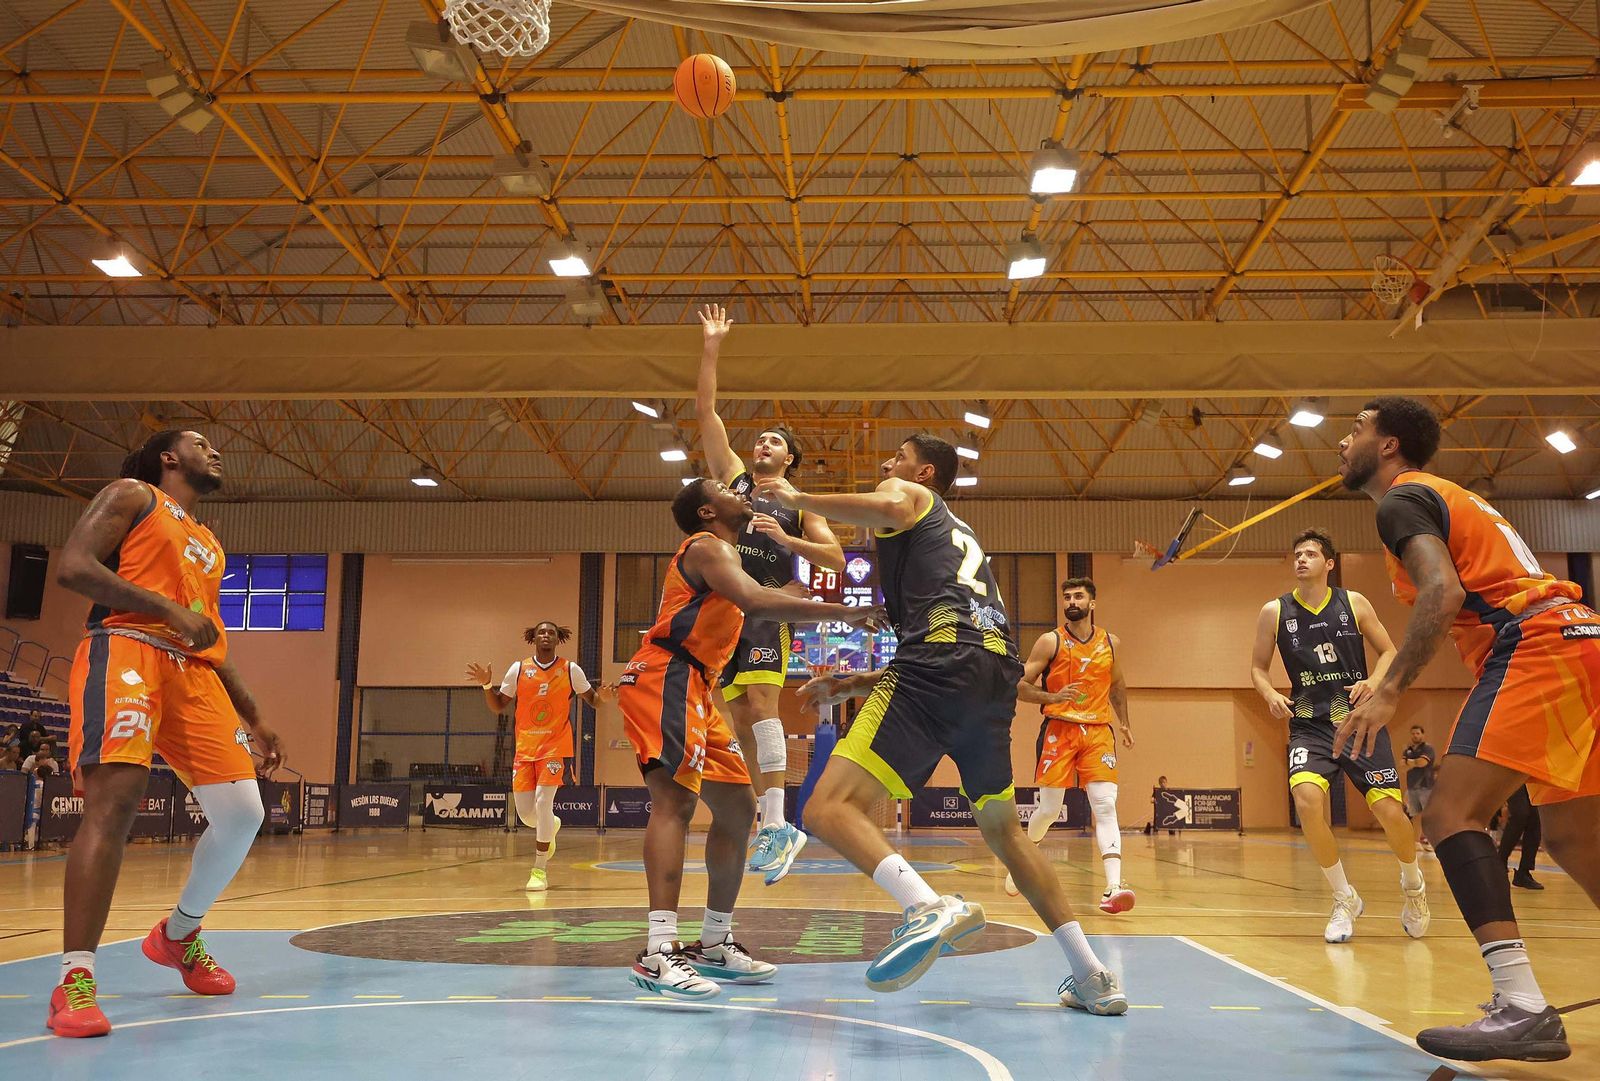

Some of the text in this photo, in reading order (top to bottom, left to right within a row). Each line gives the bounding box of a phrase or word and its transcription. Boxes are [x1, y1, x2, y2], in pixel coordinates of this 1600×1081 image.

[813, 573, 837, 590] 20
[1313, 642, 1339, 665] 13
[1080, 657, 1093, 673] 7
[537, 682, 550, 697] 2
[110, 708, 153, 743] 24
[1289, 746, 1310, 769] 13
[1042, 759, 1053, 775] 7
[930, 811, 973, 820] ASESORES
